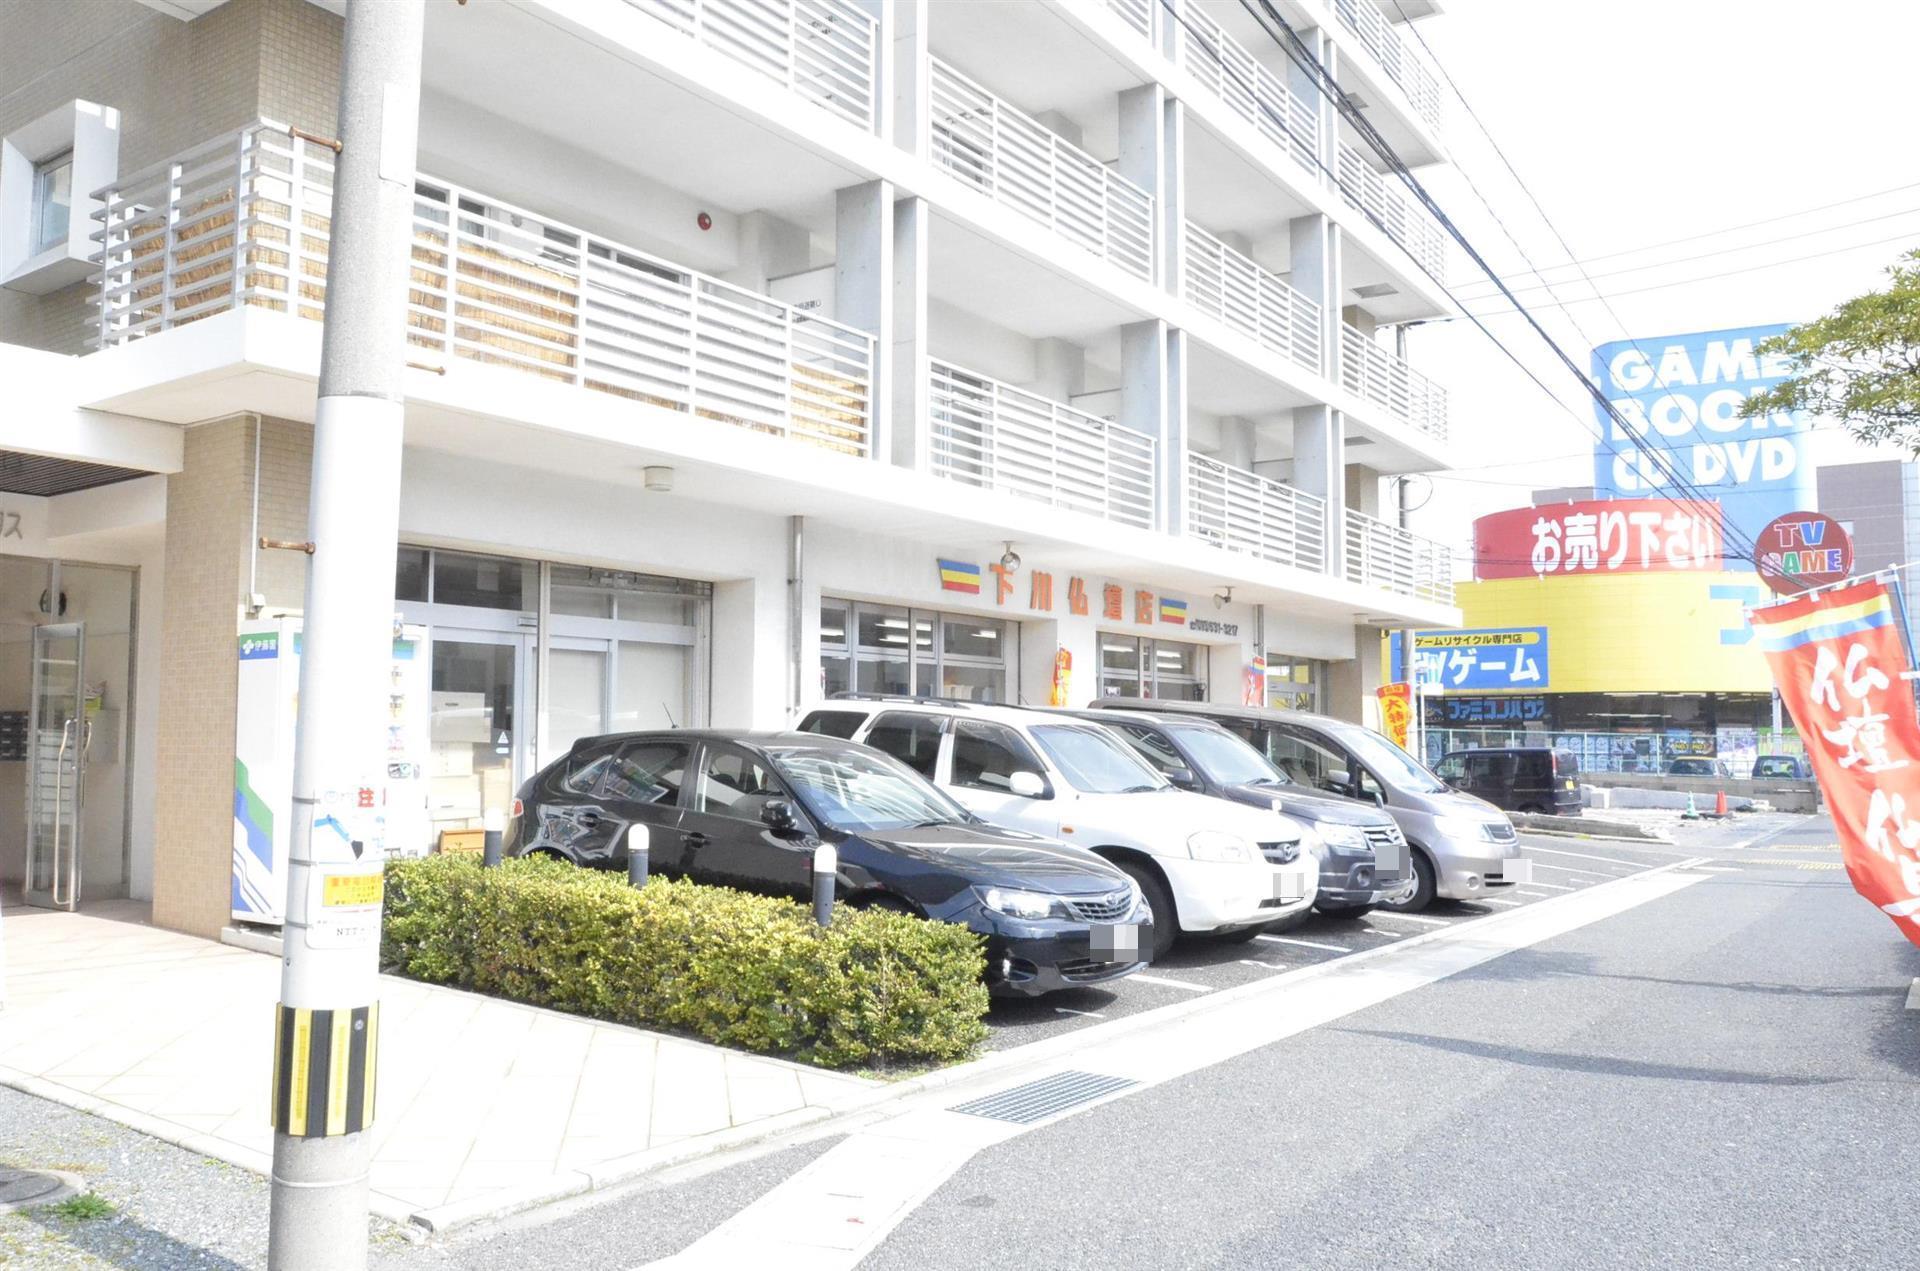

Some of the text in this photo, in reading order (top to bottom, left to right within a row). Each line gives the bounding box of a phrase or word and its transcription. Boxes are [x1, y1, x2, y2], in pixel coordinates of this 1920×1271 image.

[1610, 334, 1797, 391] GAME
[1612, 386, 1794, 441] BOOK
[1613, 438, 1797, 490] CD DVD
[1531, 511, 1714, 573] お売り下さい
[1773, 521, 1826, 547] TV
[1761, 548, 1842, 577] GAME
[1415, 633, 1522, 646] ゲームリサイクル専門店
